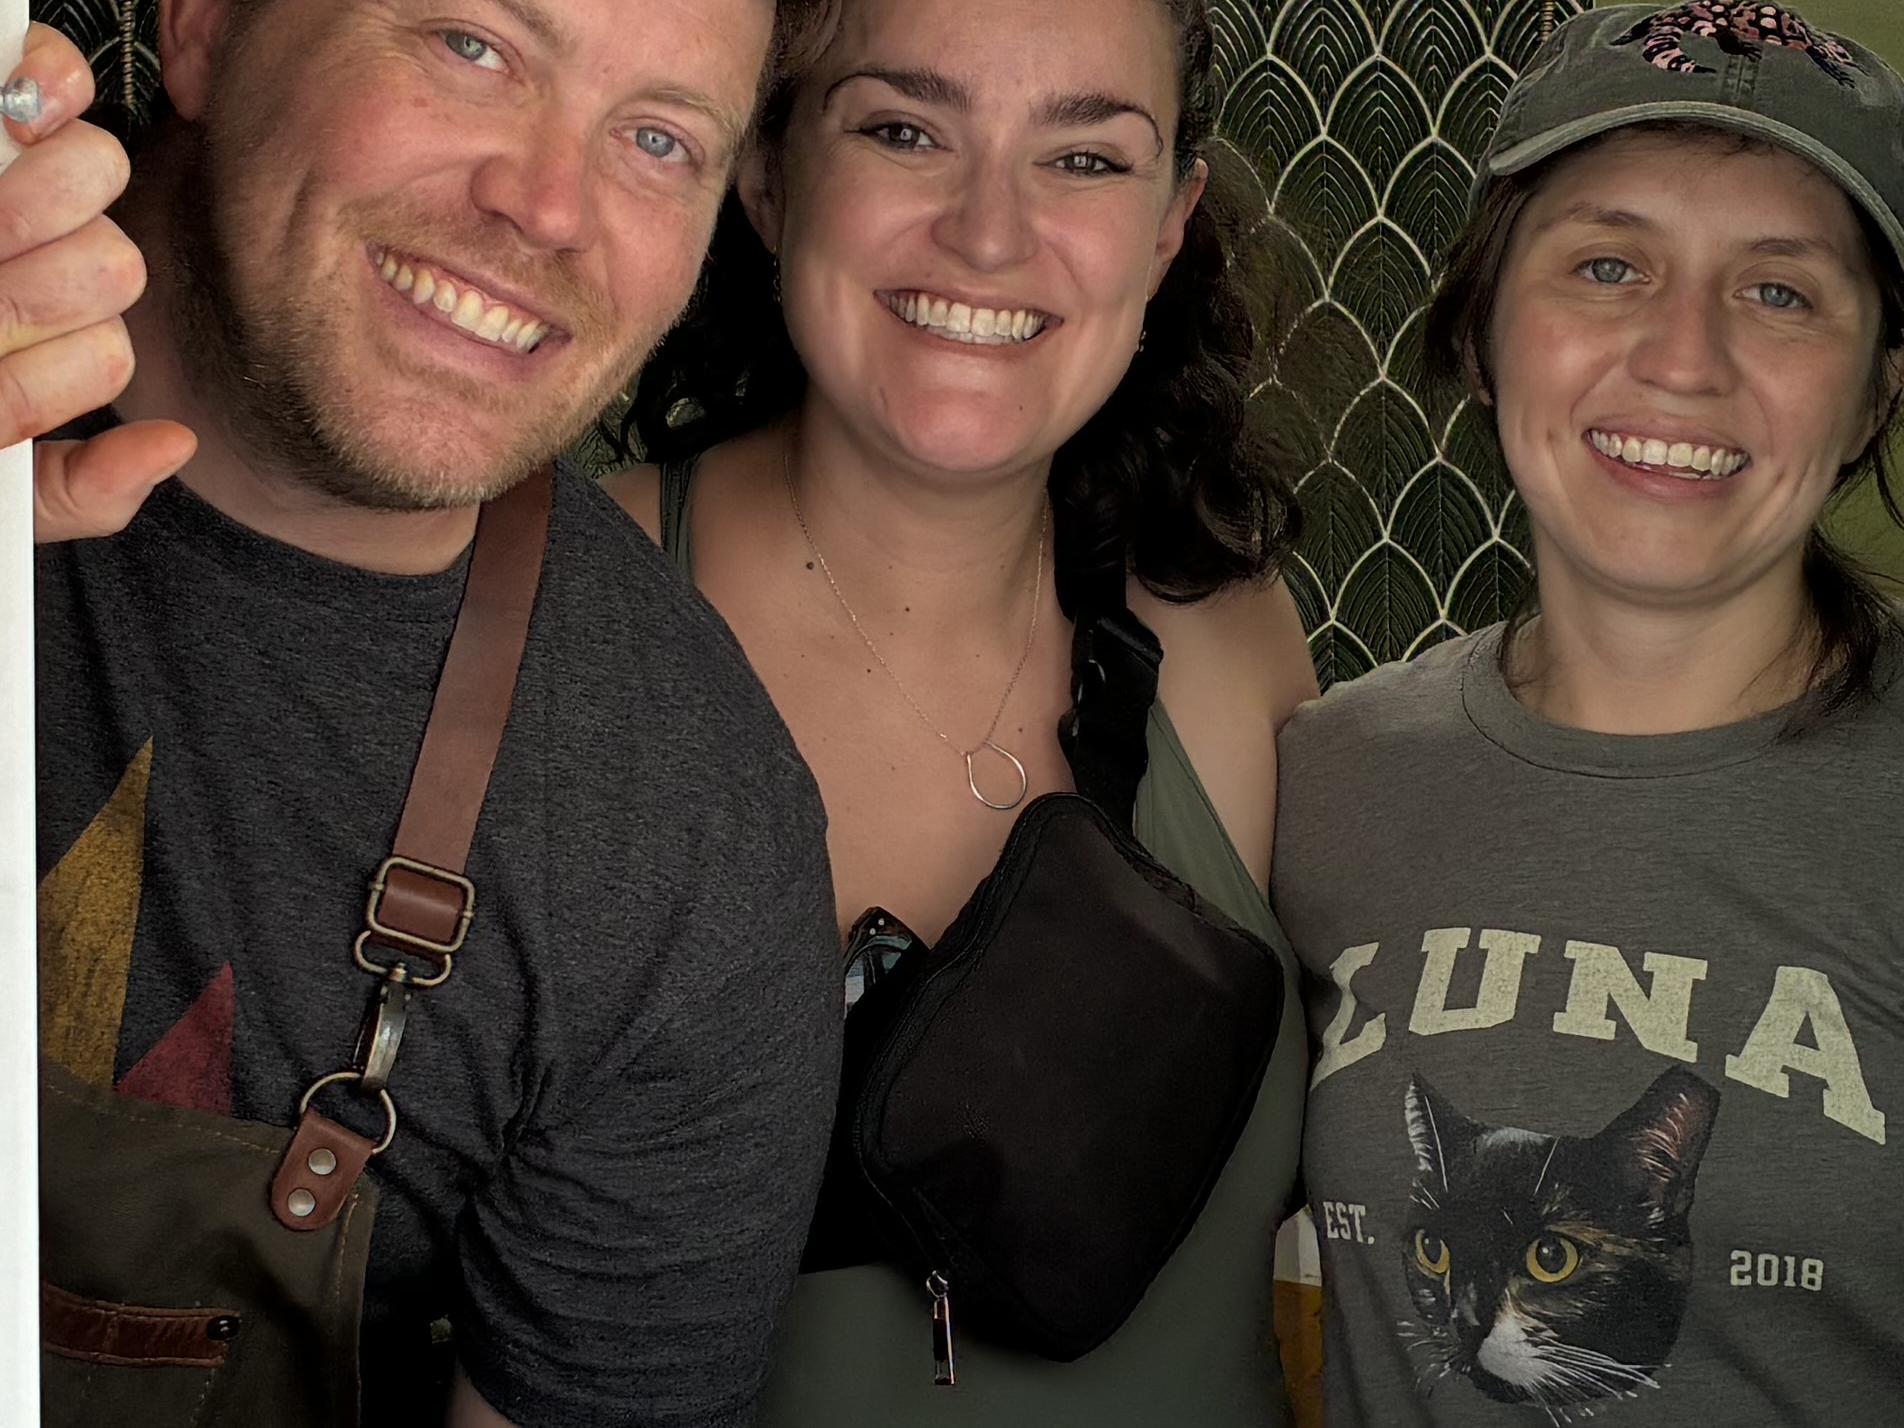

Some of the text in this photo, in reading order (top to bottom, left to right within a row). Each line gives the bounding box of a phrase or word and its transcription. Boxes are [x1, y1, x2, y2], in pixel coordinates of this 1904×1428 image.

[1310, 926, 1887, 1146] LUNA
[1322, 1201, 1376, 1246] EST.
[1730, 1250, 1824, 1293] 2018
